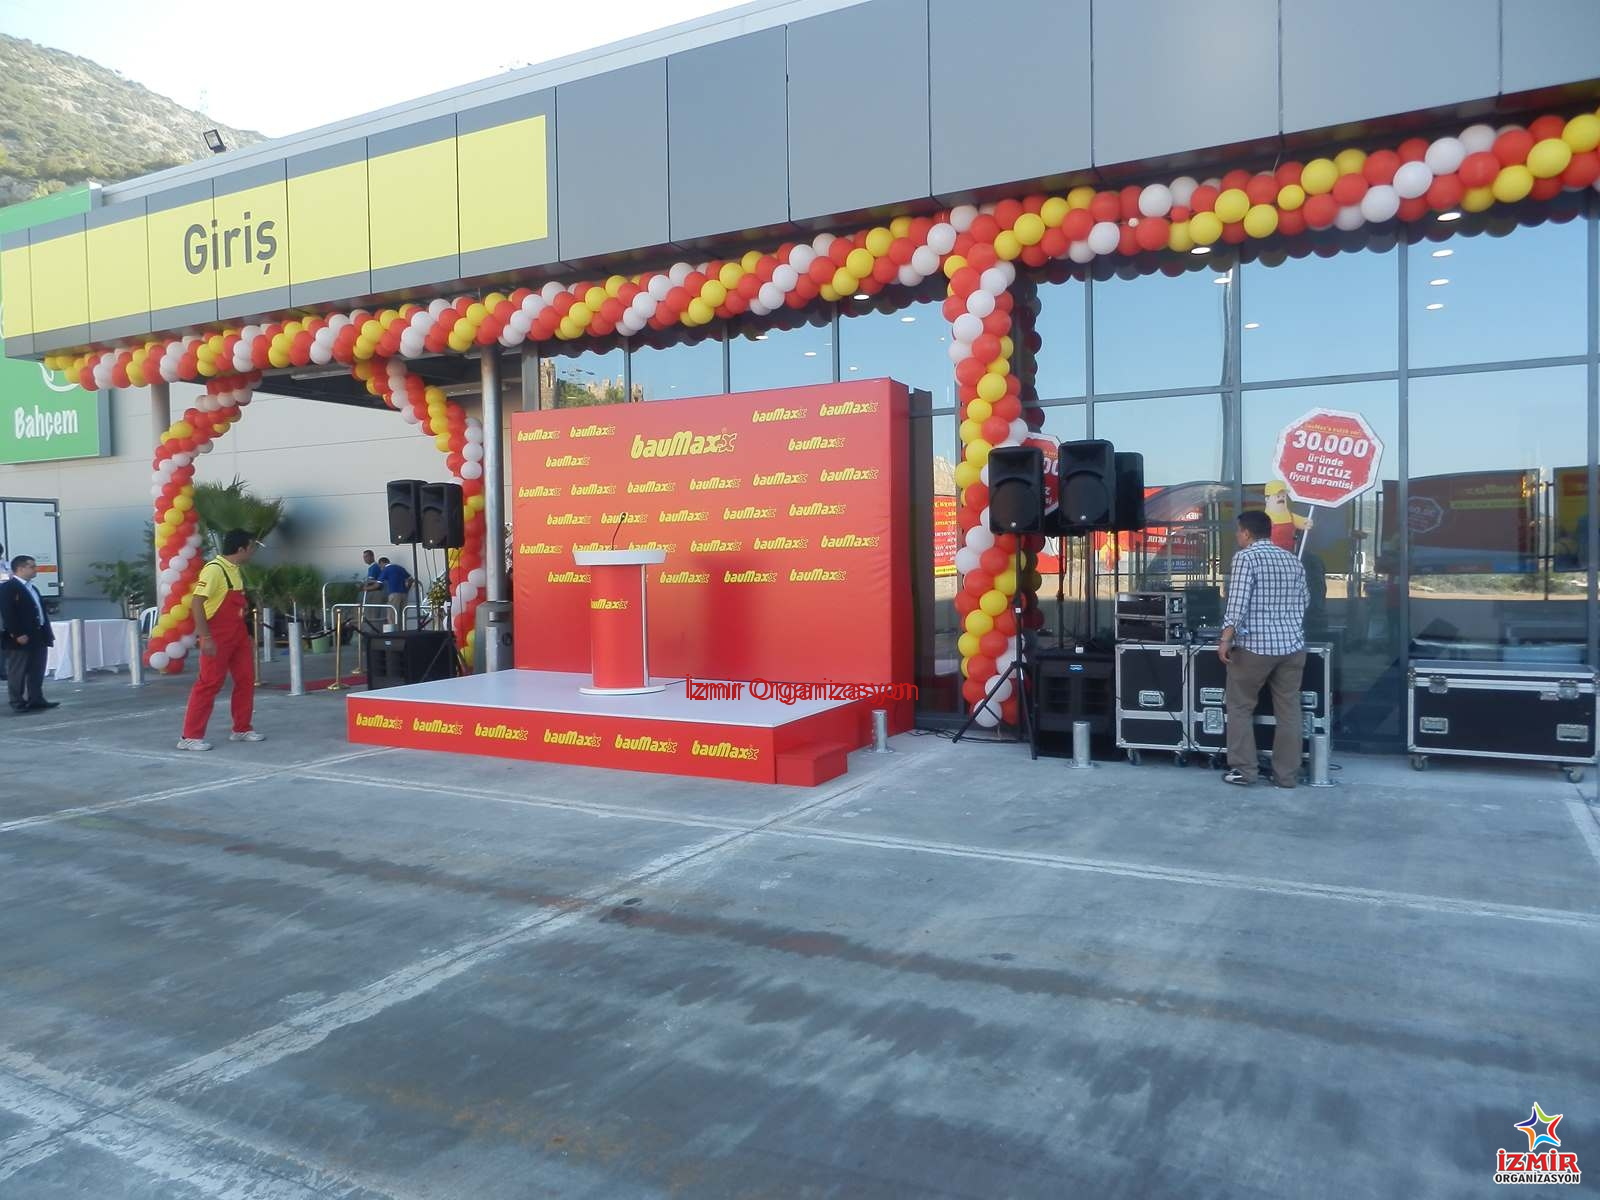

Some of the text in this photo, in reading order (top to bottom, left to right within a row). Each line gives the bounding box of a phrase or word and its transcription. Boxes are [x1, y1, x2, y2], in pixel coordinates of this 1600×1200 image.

[184, 211, 278, 275] Giriş
[14, 404, 79, 440] Bahçem
[1292, 429, 1369, 458] 30.000
[1295, 462, 1352, 479] en ucuz
[1307, 453, 1344, 467] üründe
[1289, 471, 1353, 490] fiyat garantisi
